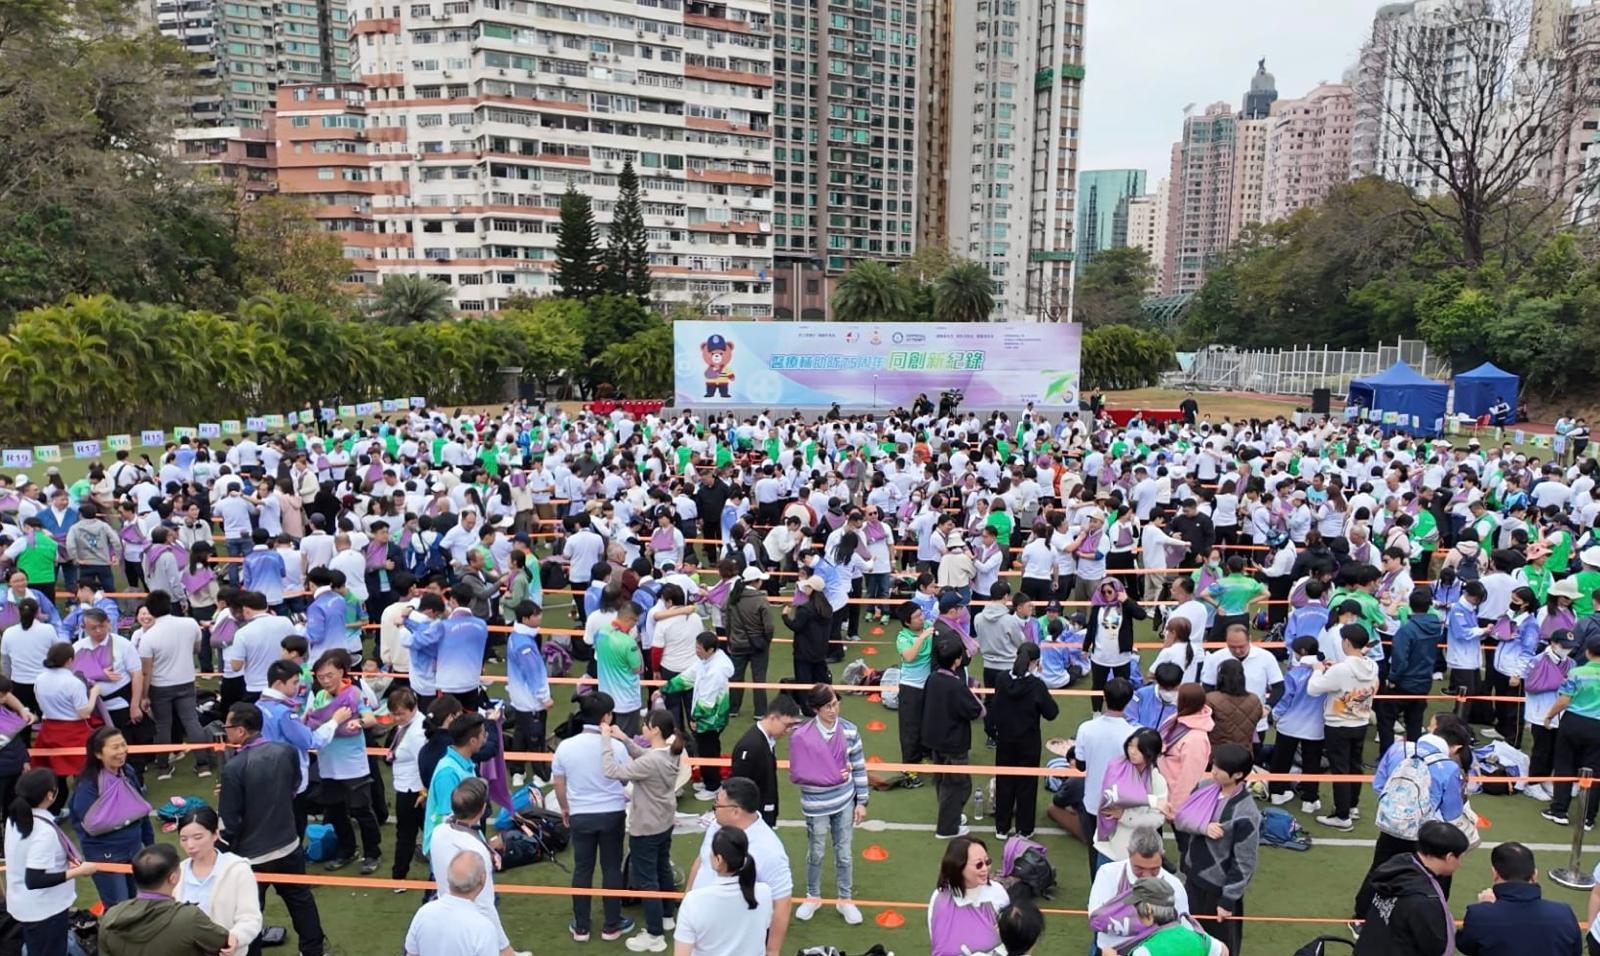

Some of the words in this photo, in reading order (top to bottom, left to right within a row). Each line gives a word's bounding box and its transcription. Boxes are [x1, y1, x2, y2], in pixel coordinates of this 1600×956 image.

[888, 350, 985, 371] 同創新紀錄
[144, 433, 162, 442] R15
[110, 438, 128, 446] R16
[77, 444, 97, 453] R17
[38, 449, 57, 457] R18
[6, 454, 28, 462] R19
